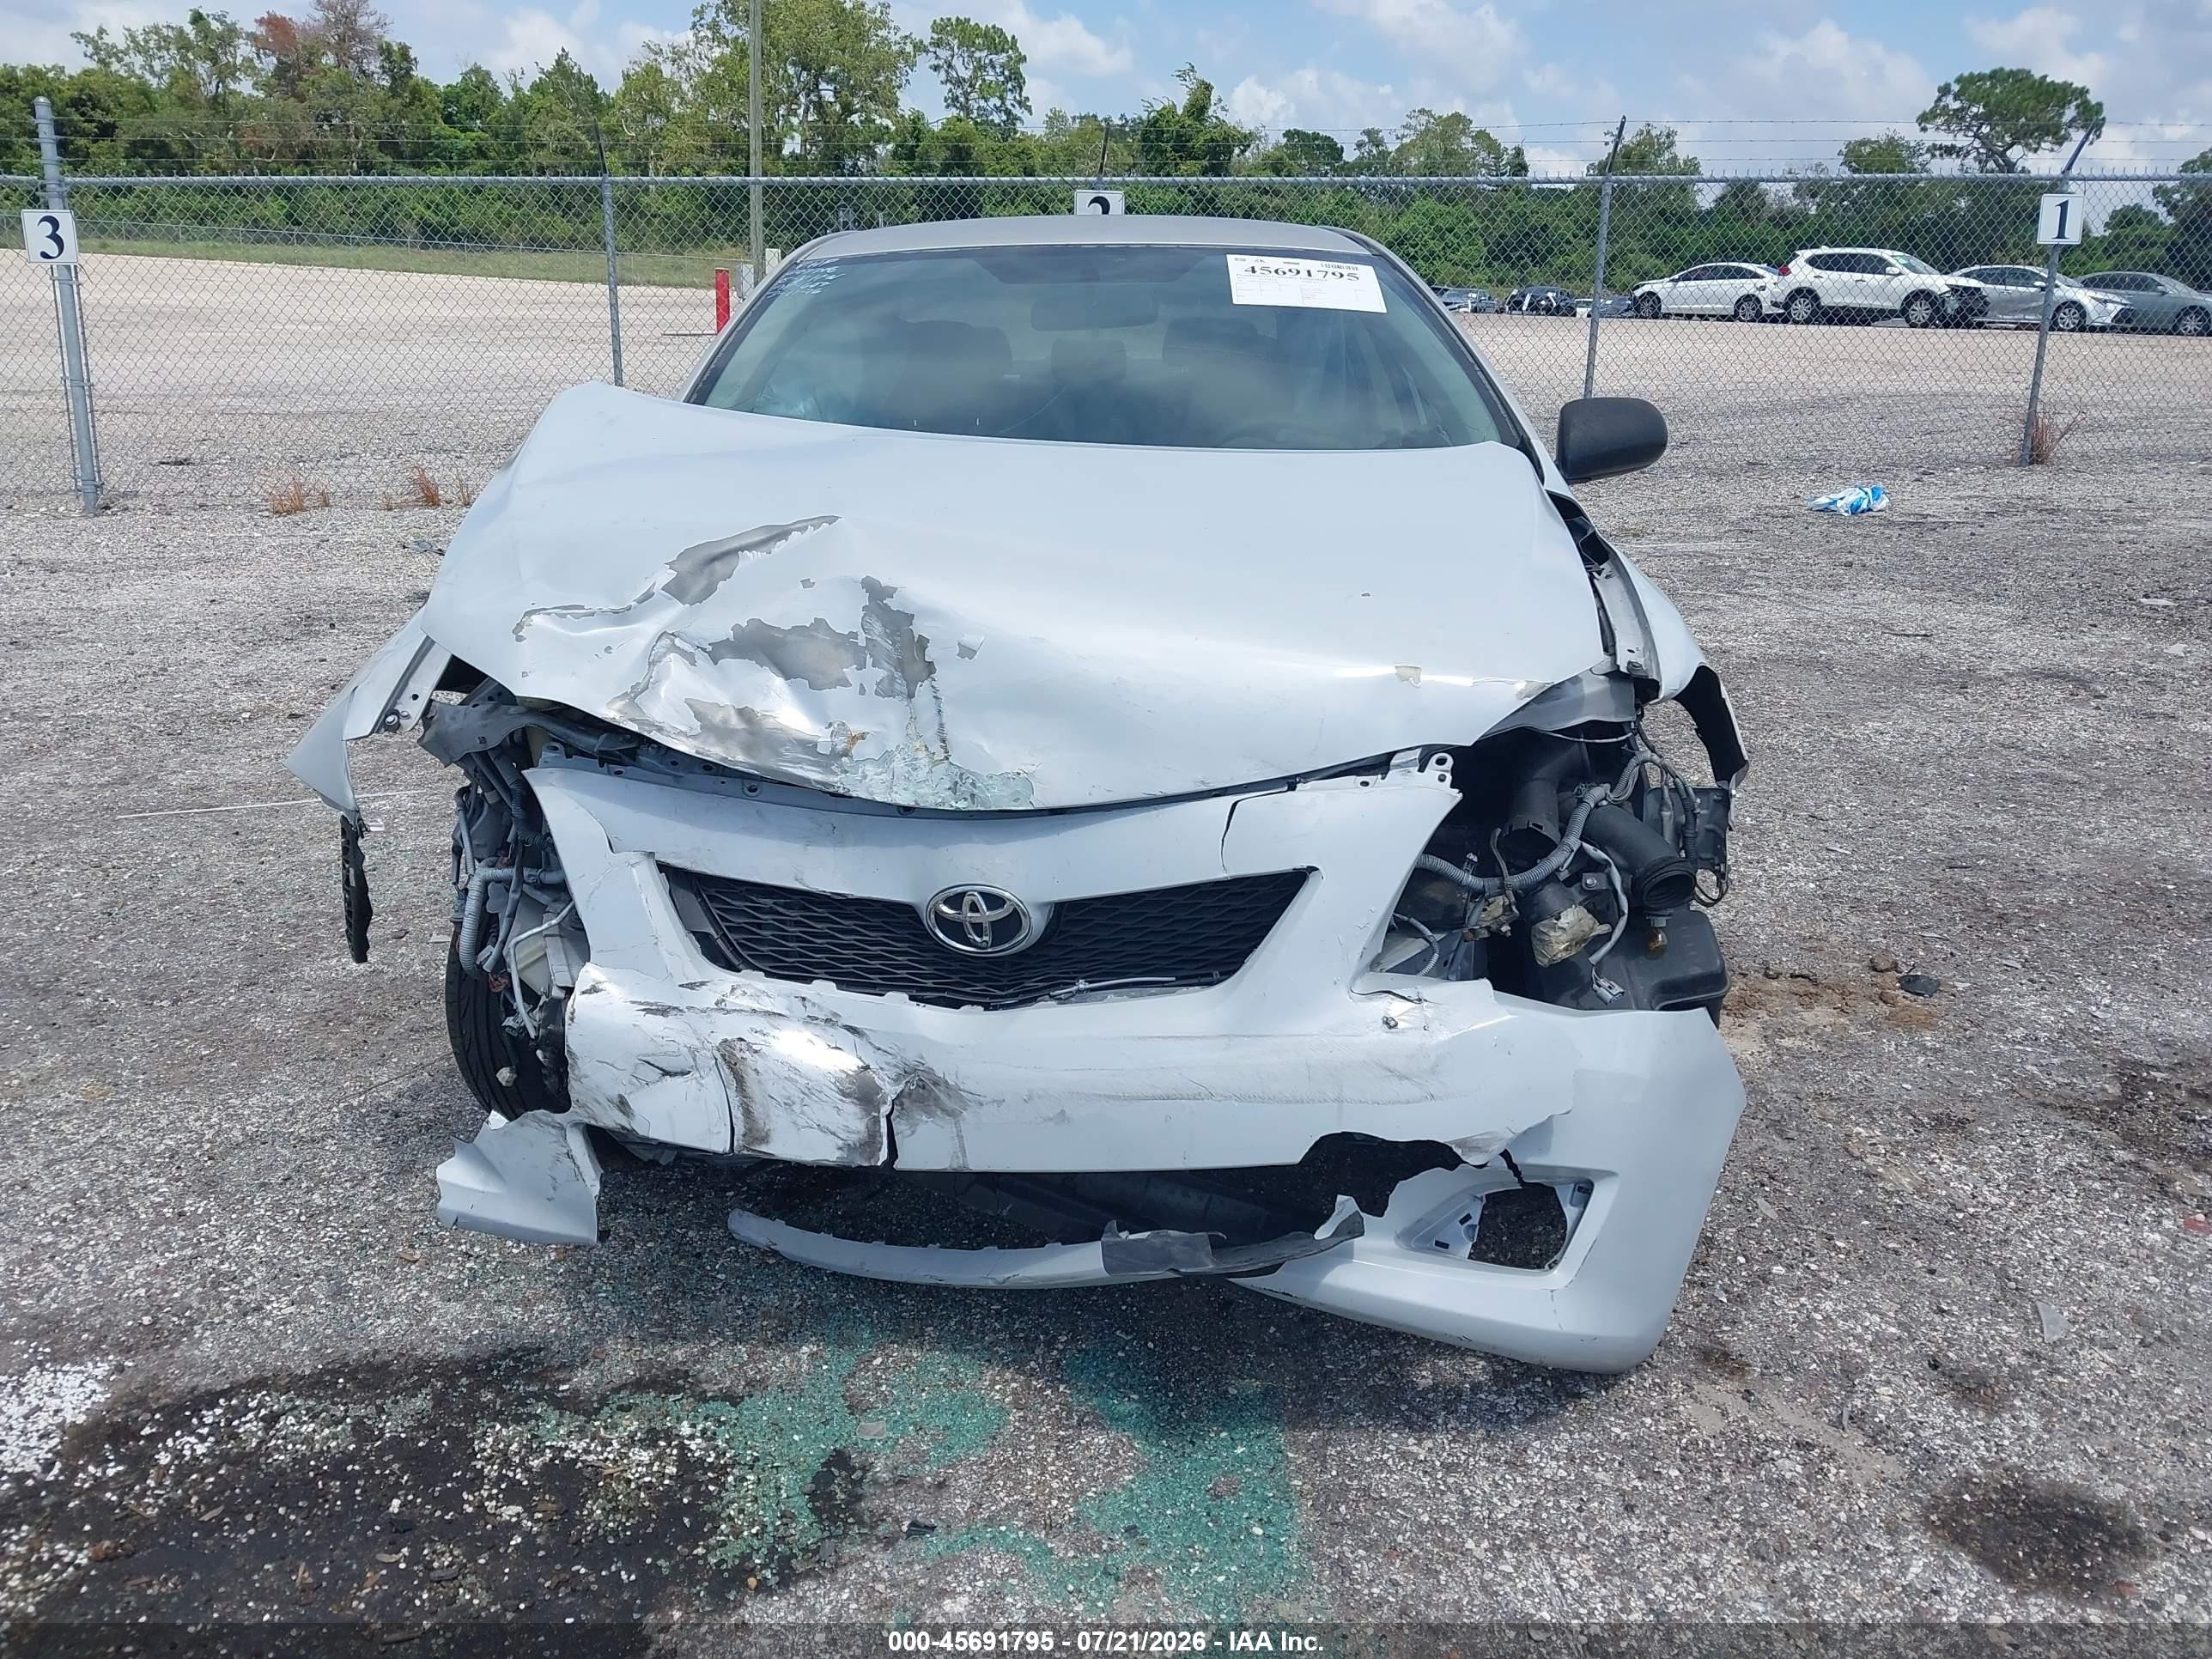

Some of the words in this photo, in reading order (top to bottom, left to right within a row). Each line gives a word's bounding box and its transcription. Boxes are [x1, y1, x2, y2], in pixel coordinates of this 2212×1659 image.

[37, 215, 64, 260] 3
[2051, 199, 2070, 240] 1
[1243, 265, 1360, 282] 45691795
